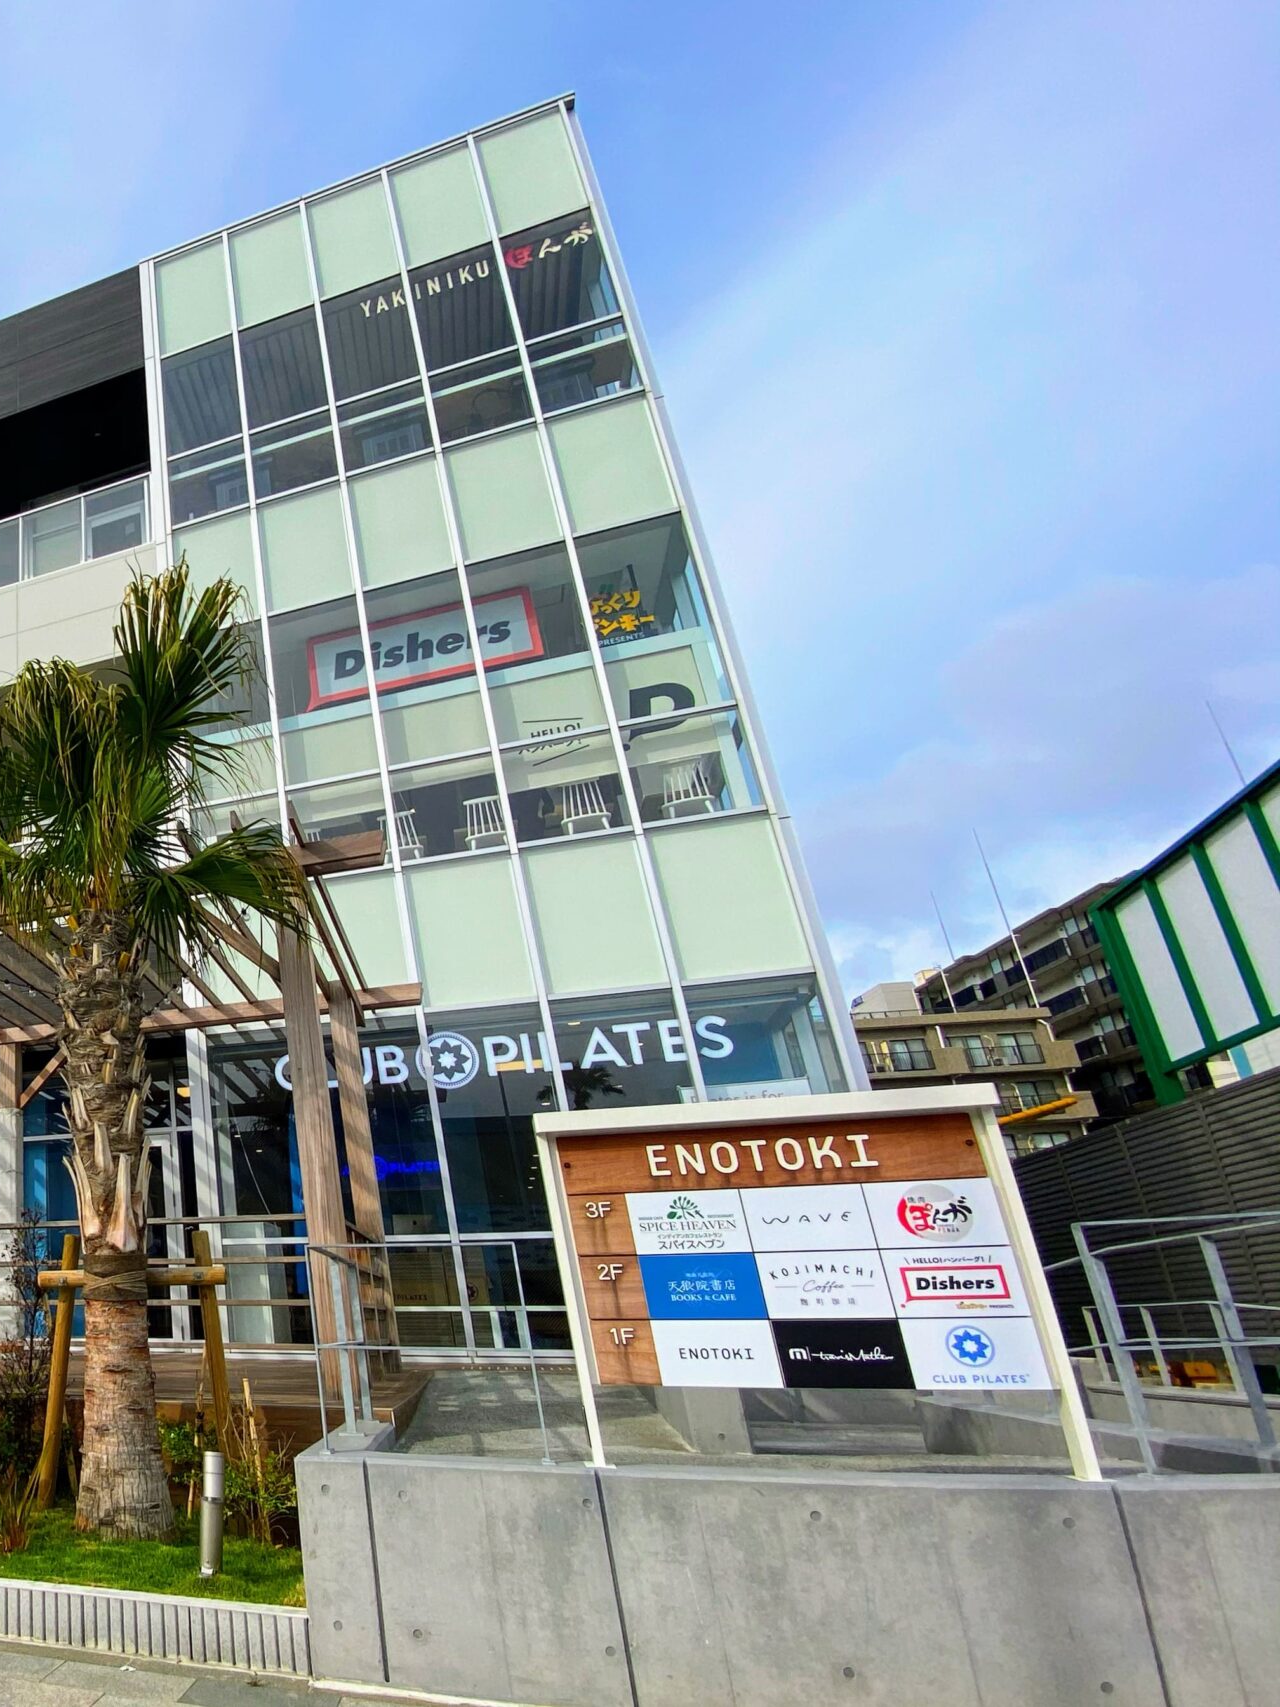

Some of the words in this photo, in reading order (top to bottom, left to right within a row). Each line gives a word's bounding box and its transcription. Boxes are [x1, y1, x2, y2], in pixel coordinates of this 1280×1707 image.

[360, 260, 490, 318] YAKINIKU
[334, 620, 511, 680] Dishers
[482, 1016, 734, 1077] PILATES
[645, 1134, 879, 1177] ENOTOKI
[585, 1202, 611, 1218] 3F
[639, 1222, 678, 1232] SPICE
[680, 1219, 736, 1231] HEAVEN
[762, 1211, 852, 1225] WAVE
[658, 1240, 725, 1250] スパイスヘブン
[597, 1264, 623, 1281] 2F
[769, 1264, 874, 1280] KOJIMACHI
[802, 1280, 845, 1293] Coffee
[915, 1276, 995, 1290] Dishers
[671, 1294, 702, 1302] BOOKS
[610, 1327, 635, 1345] 1F
[679, 1347, 754, 1360] ENOTOKI
[933, 1375, 967, 1384] CLUB
[973, 1374, 1026, 1384] PILATES
